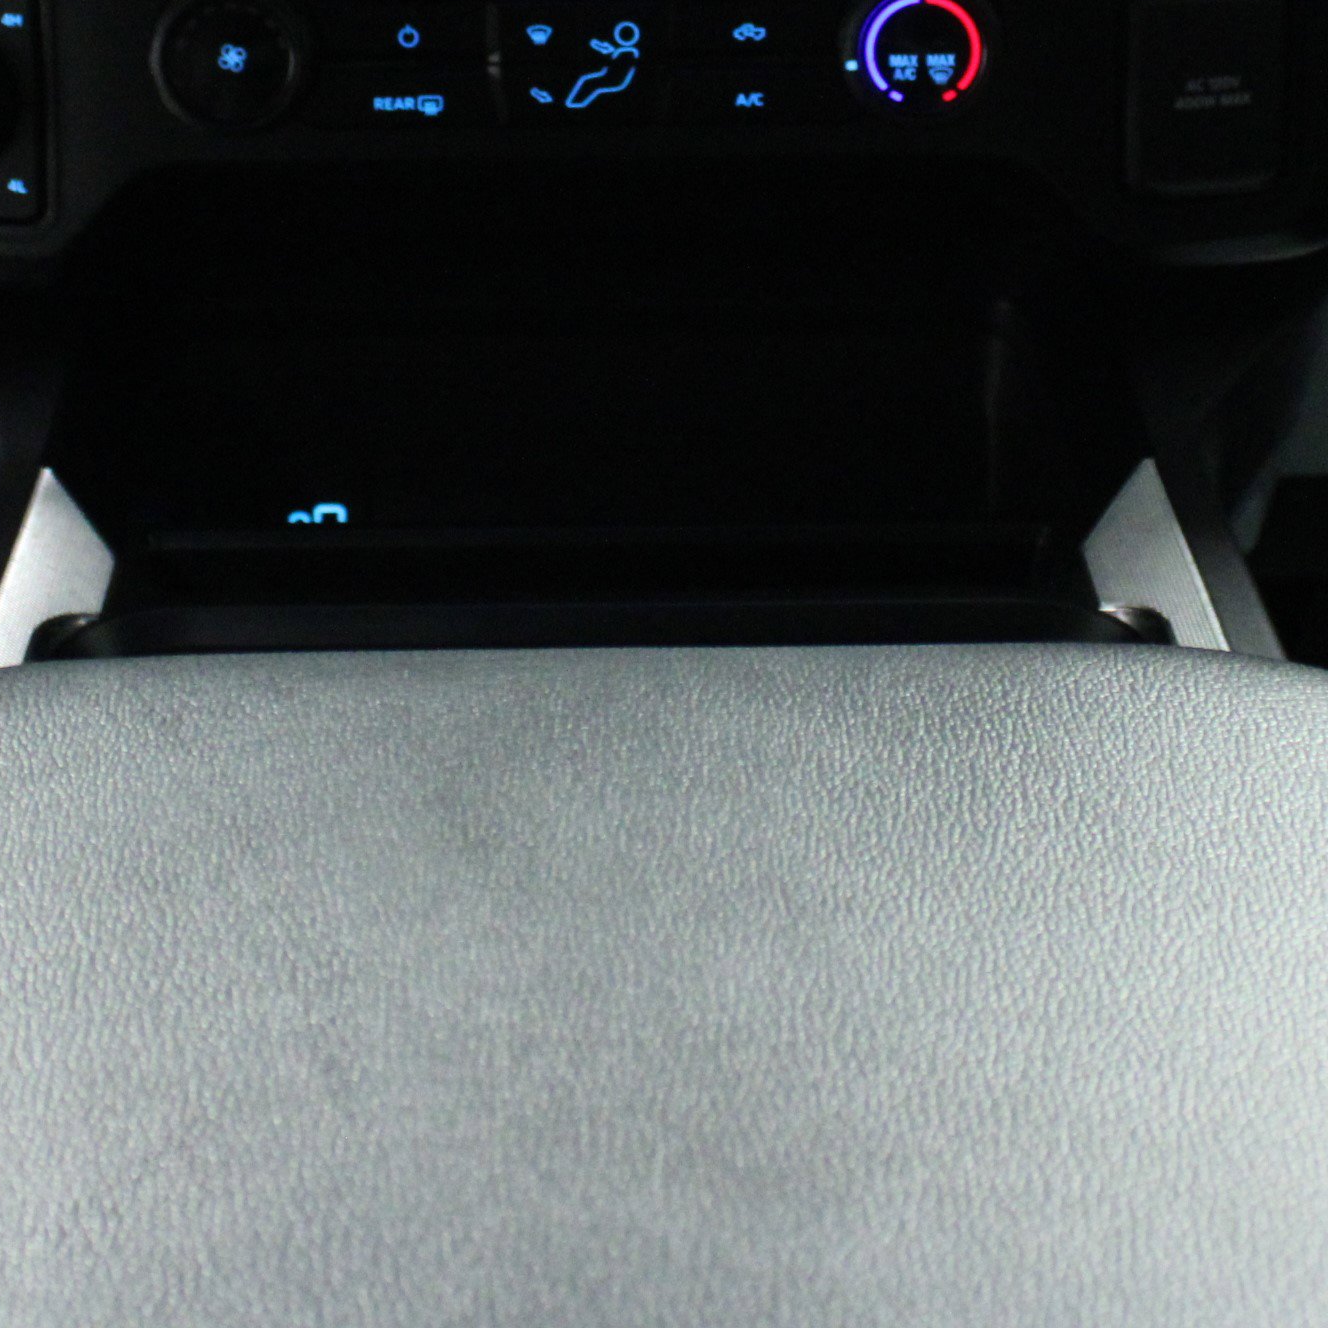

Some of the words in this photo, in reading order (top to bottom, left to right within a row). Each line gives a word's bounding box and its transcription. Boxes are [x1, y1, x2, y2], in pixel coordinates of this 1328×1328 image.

[888, 54, 919, 68] MAX
[926, 53, 956, 67] MAX
[373, 96, 415, 111] REAR
[735, 92, 765, 108] A/C
